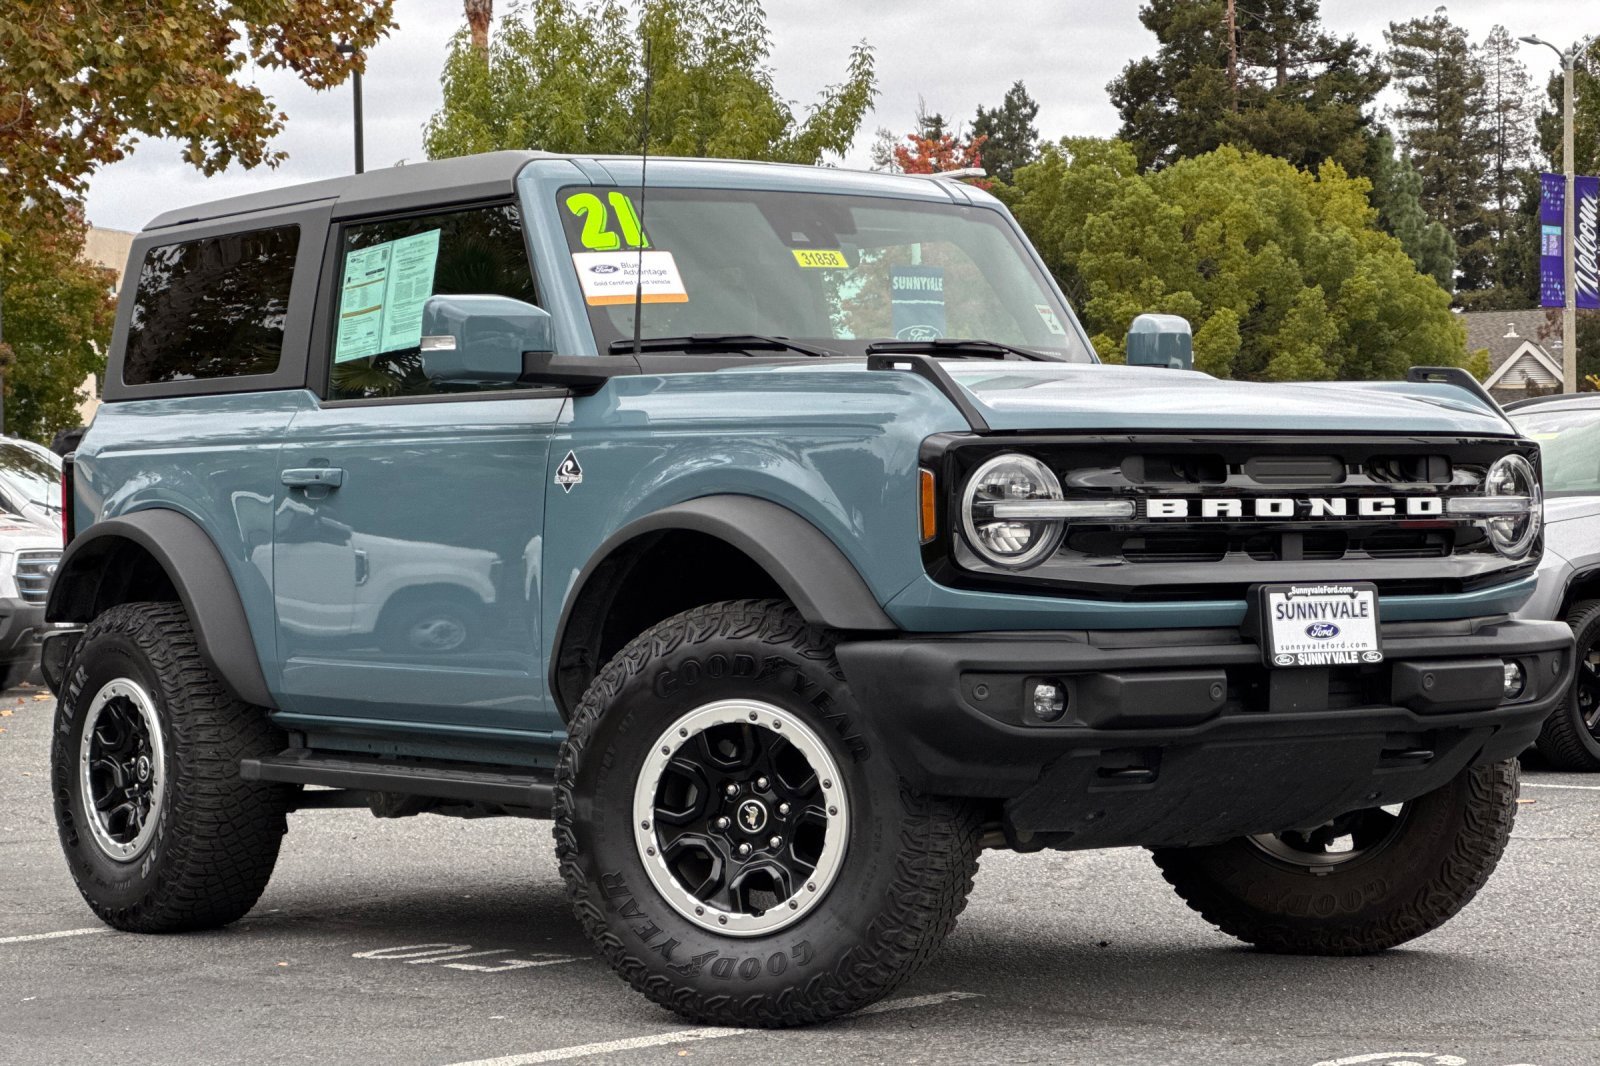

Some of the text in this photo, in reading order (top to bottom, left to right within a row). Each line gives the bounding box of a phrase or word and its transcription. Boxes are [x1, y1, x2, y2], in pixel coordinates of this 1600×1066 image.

[566, 191, 649, 251] 21
[801, 252, 839, 265] 31858
[1146, 497, 1443, 518] BRONCO
[1291, 586, 1354, 596] SunnyvaleFord.com
[1276, 601, 1369, 620] SUNNYVALE
[1308, 623, 1336, 638] Ford
[1280, 641, 1368, 651] sunnyvaleford.com
[1297, 652, 1359, 665] SUNNYVALE
